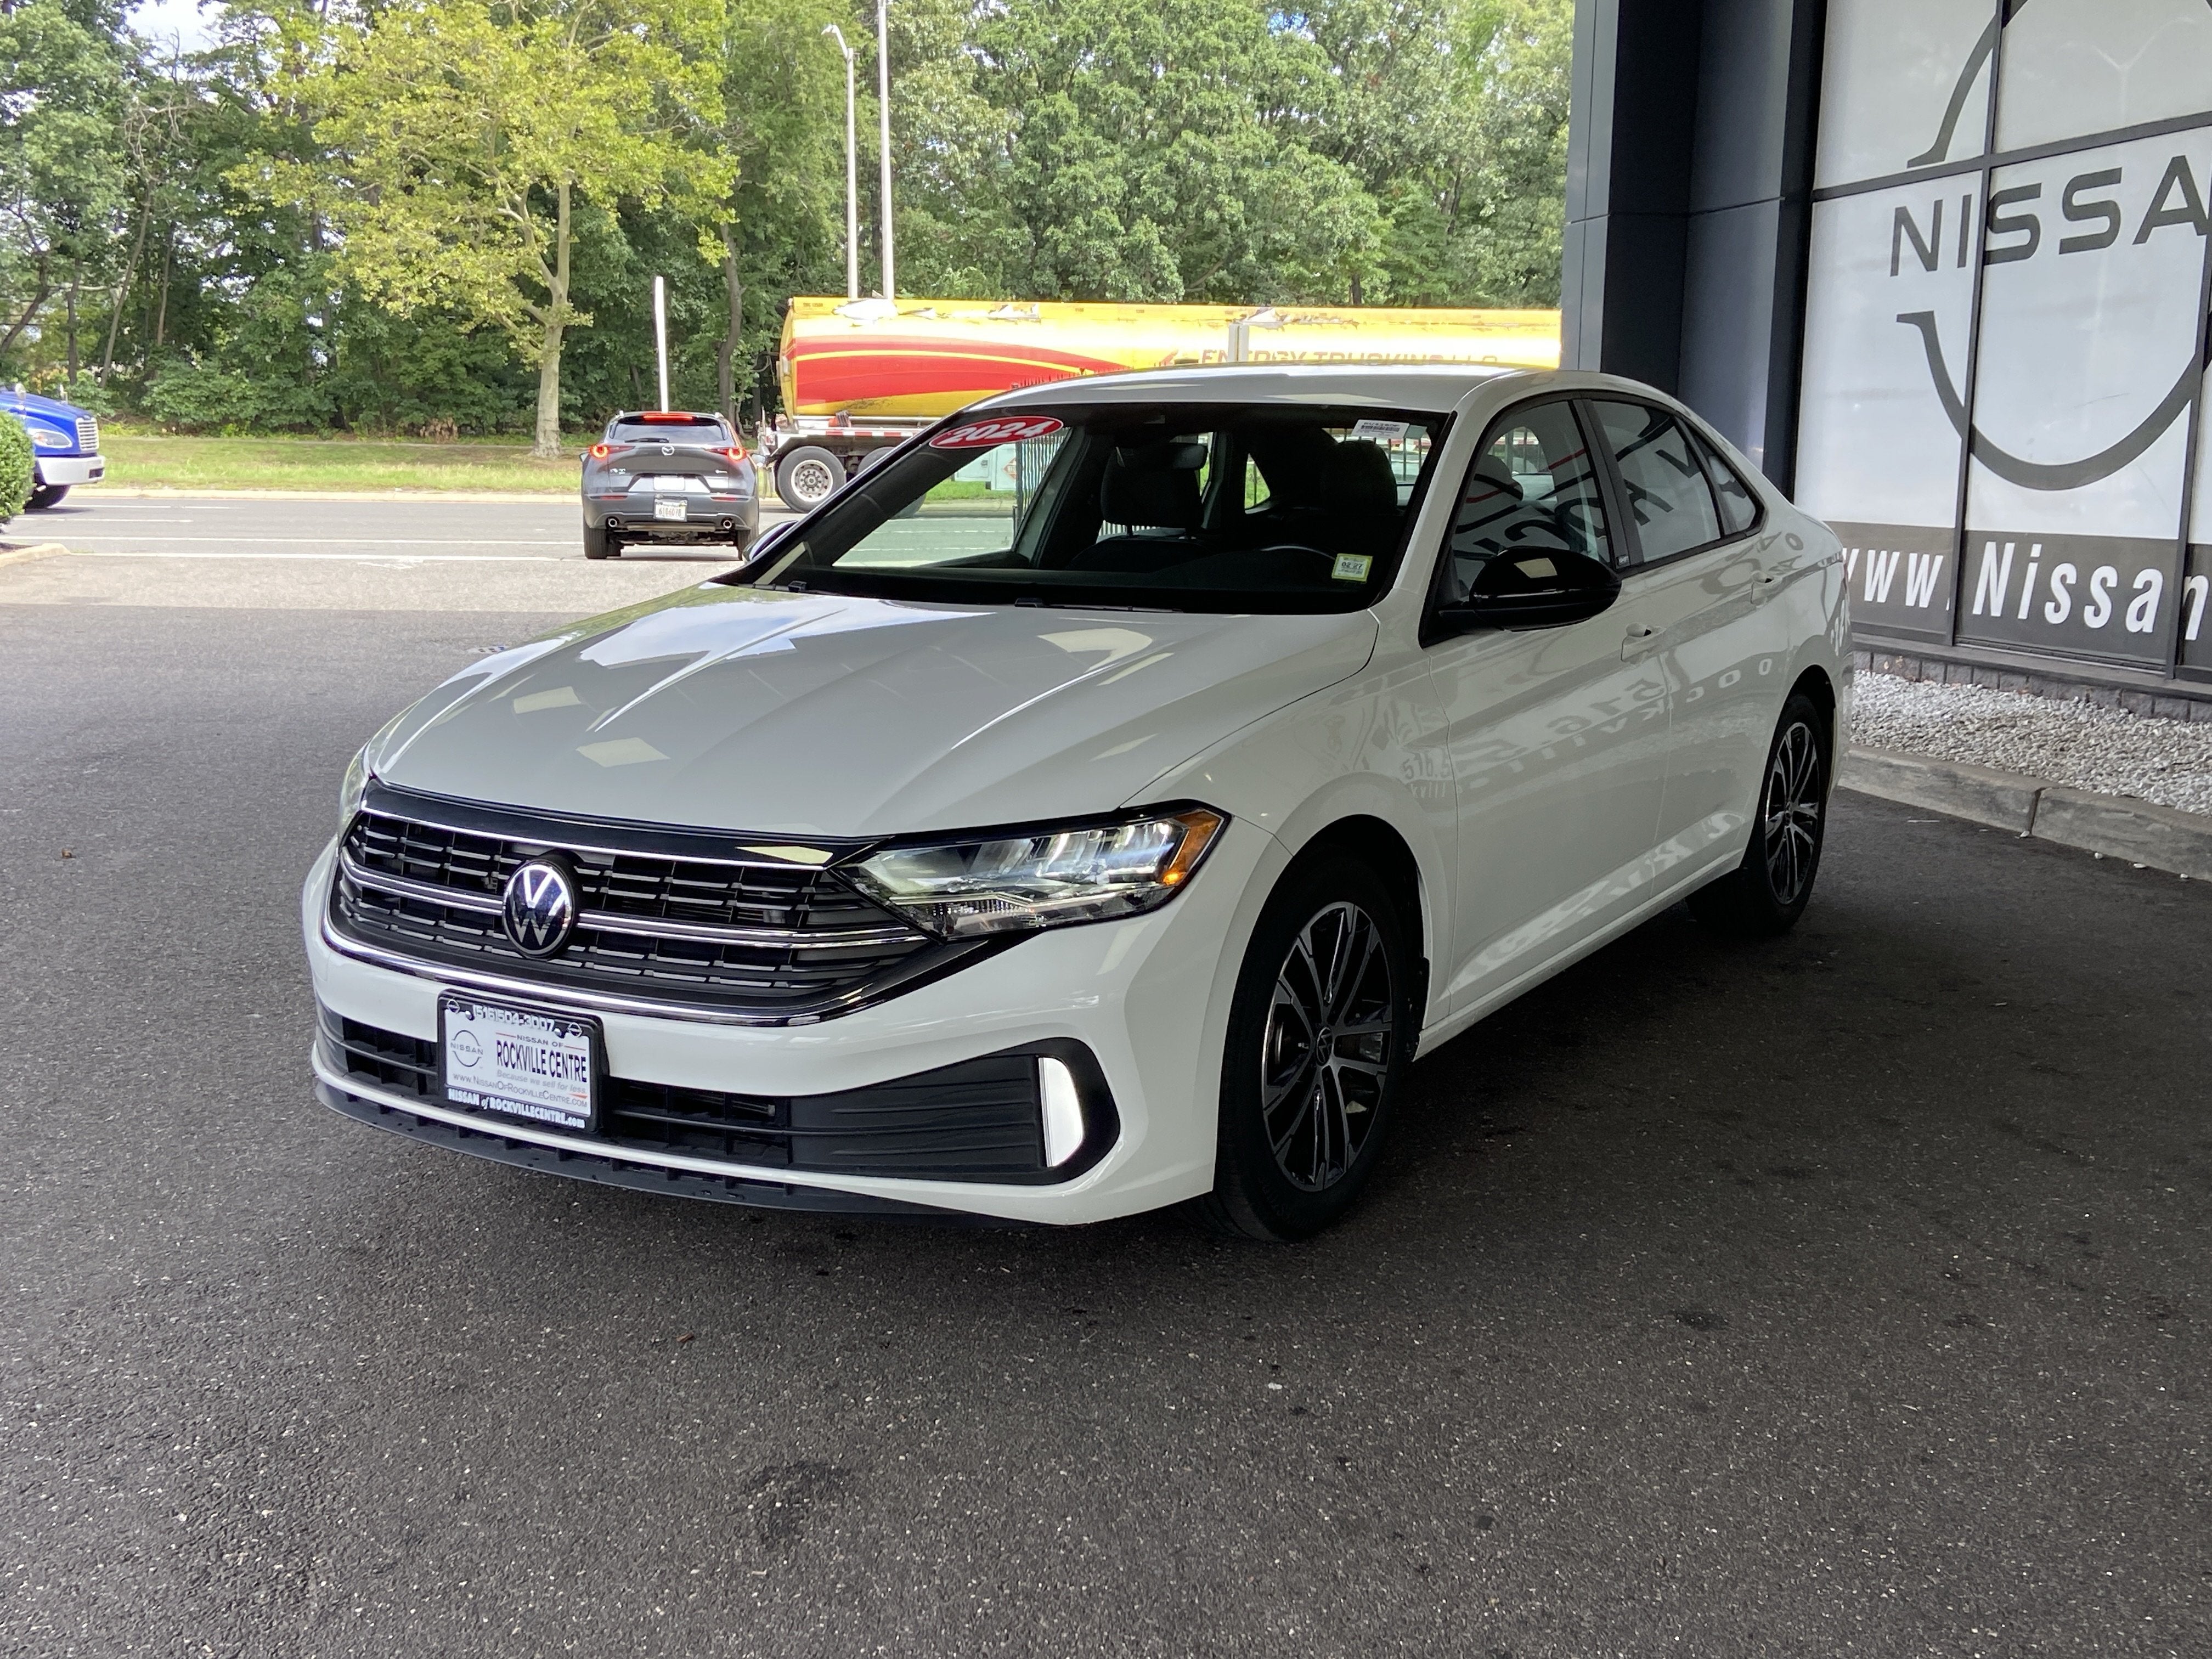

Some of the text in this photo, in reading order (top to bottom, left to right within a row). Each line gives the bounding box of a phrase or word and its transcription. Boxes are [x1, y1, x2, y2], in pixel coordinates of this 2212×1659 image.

[936, 421, 1055, 445] 2024
[517, 1035, 548, 1045] NISSAN
[496, 1040, 587, 1082] ROCKVILLE CENTRE
[497, 1069, 528, 1082] Because
[557, 1082, 568, 1091] for
[448, 1088, 479, 1105] NISSAN
[481, 1097, 489, 1110] of
